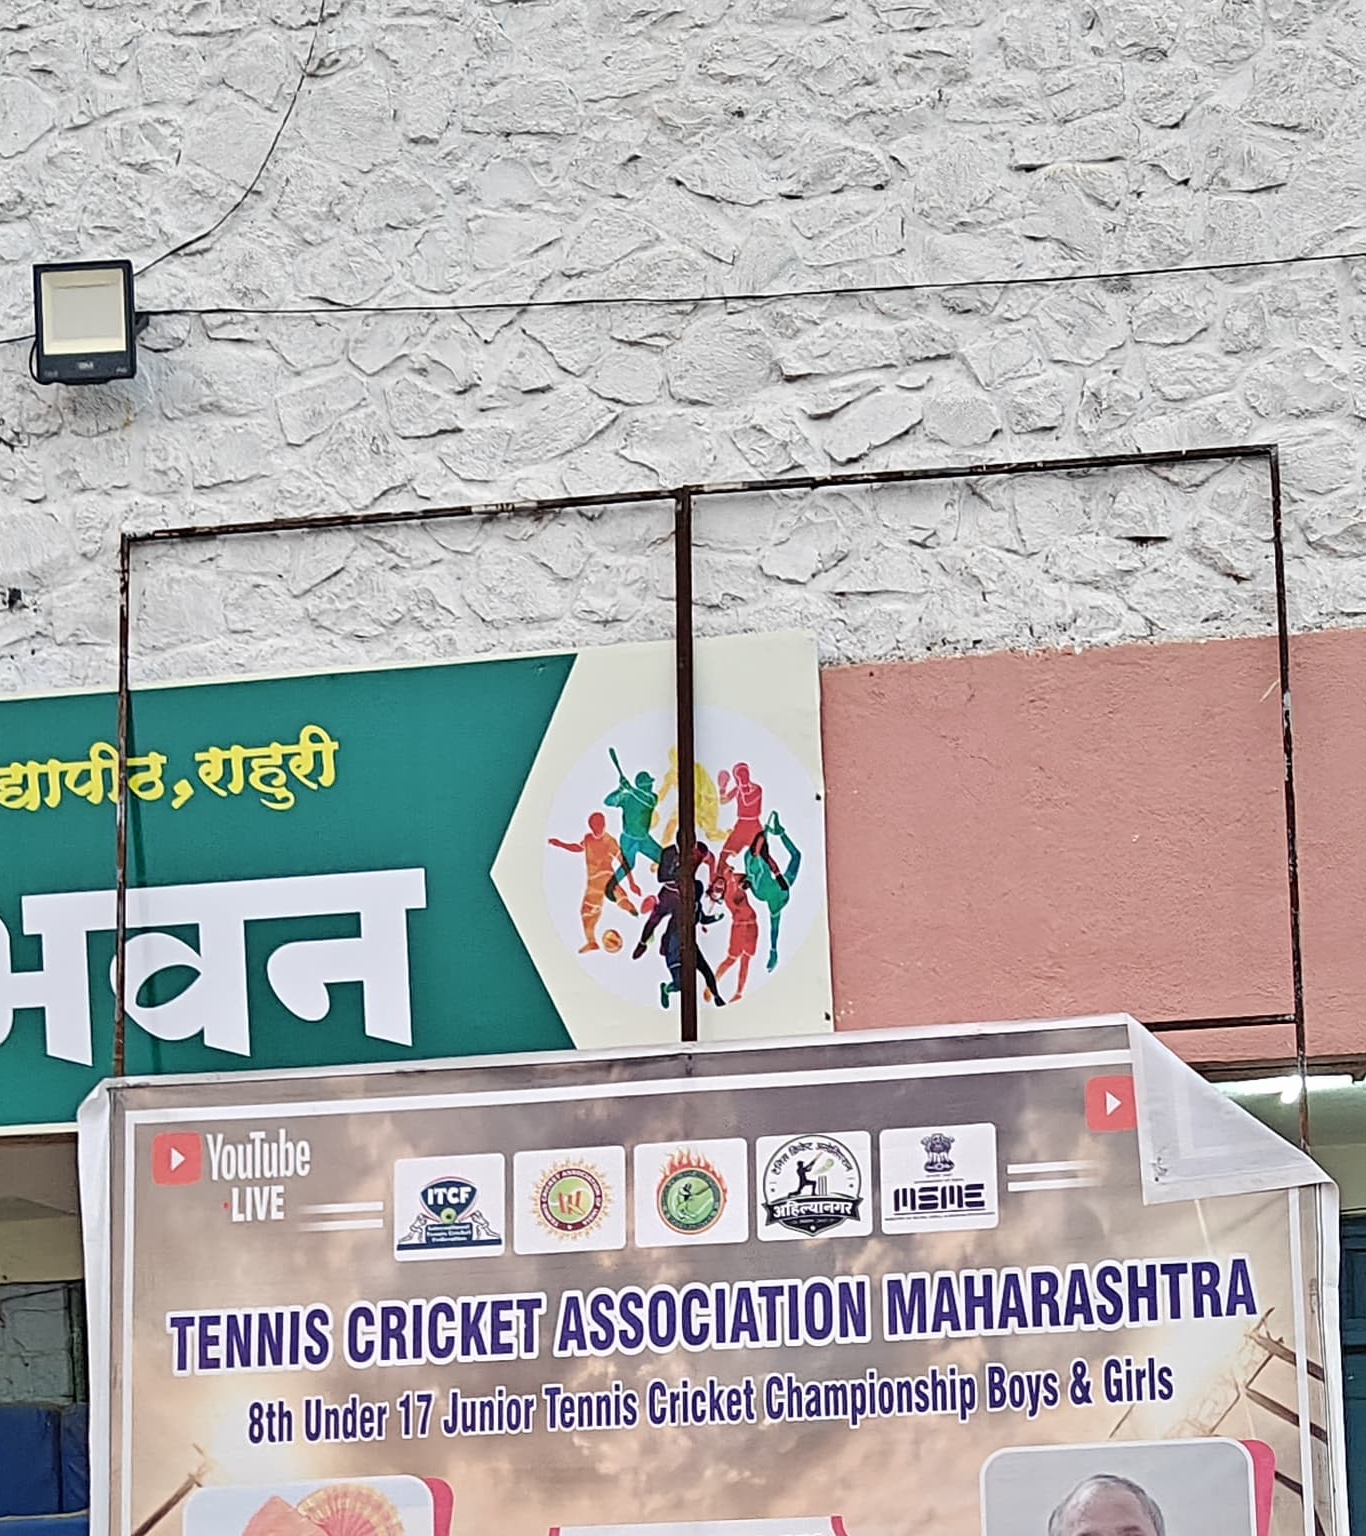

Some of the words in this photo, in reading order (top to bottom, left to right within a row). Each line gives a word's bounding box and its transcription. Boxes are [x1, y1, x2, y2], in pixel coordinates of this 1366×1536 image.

[206, 1129, 311, 1181] YouTube
[231, 1185, 285, 1223] LIVE
[427, 1186, 472, 1205] ITCF
[773, 1201, 853, 1218] अहिल्यानगर
[168, 1308, 330, 1371] TENNIS
[347, 1298, 543, 1363] CRICKET
[557, 1281, 868, 1352] ASSOCIATION
[887, 1259, 1258, 1336] MAHARASHTRA
[248, 1400, 293, 1444] 8th
[304, 1397, 388, 1442] Under
[398, 1393, 434, 1436] 17
[443, 1389, 534, 1434] Junior
[543, 1386, 637, 1430] Tennis
[648, 1379, 754, 1424] Cricket
[766, 1368, 975, 1425] Championship
[986, 1364, 1059, 1419] Boys
[1071, 1361, 1091, 1402] &
[1105, 1358, 1174, 1402] Girls
